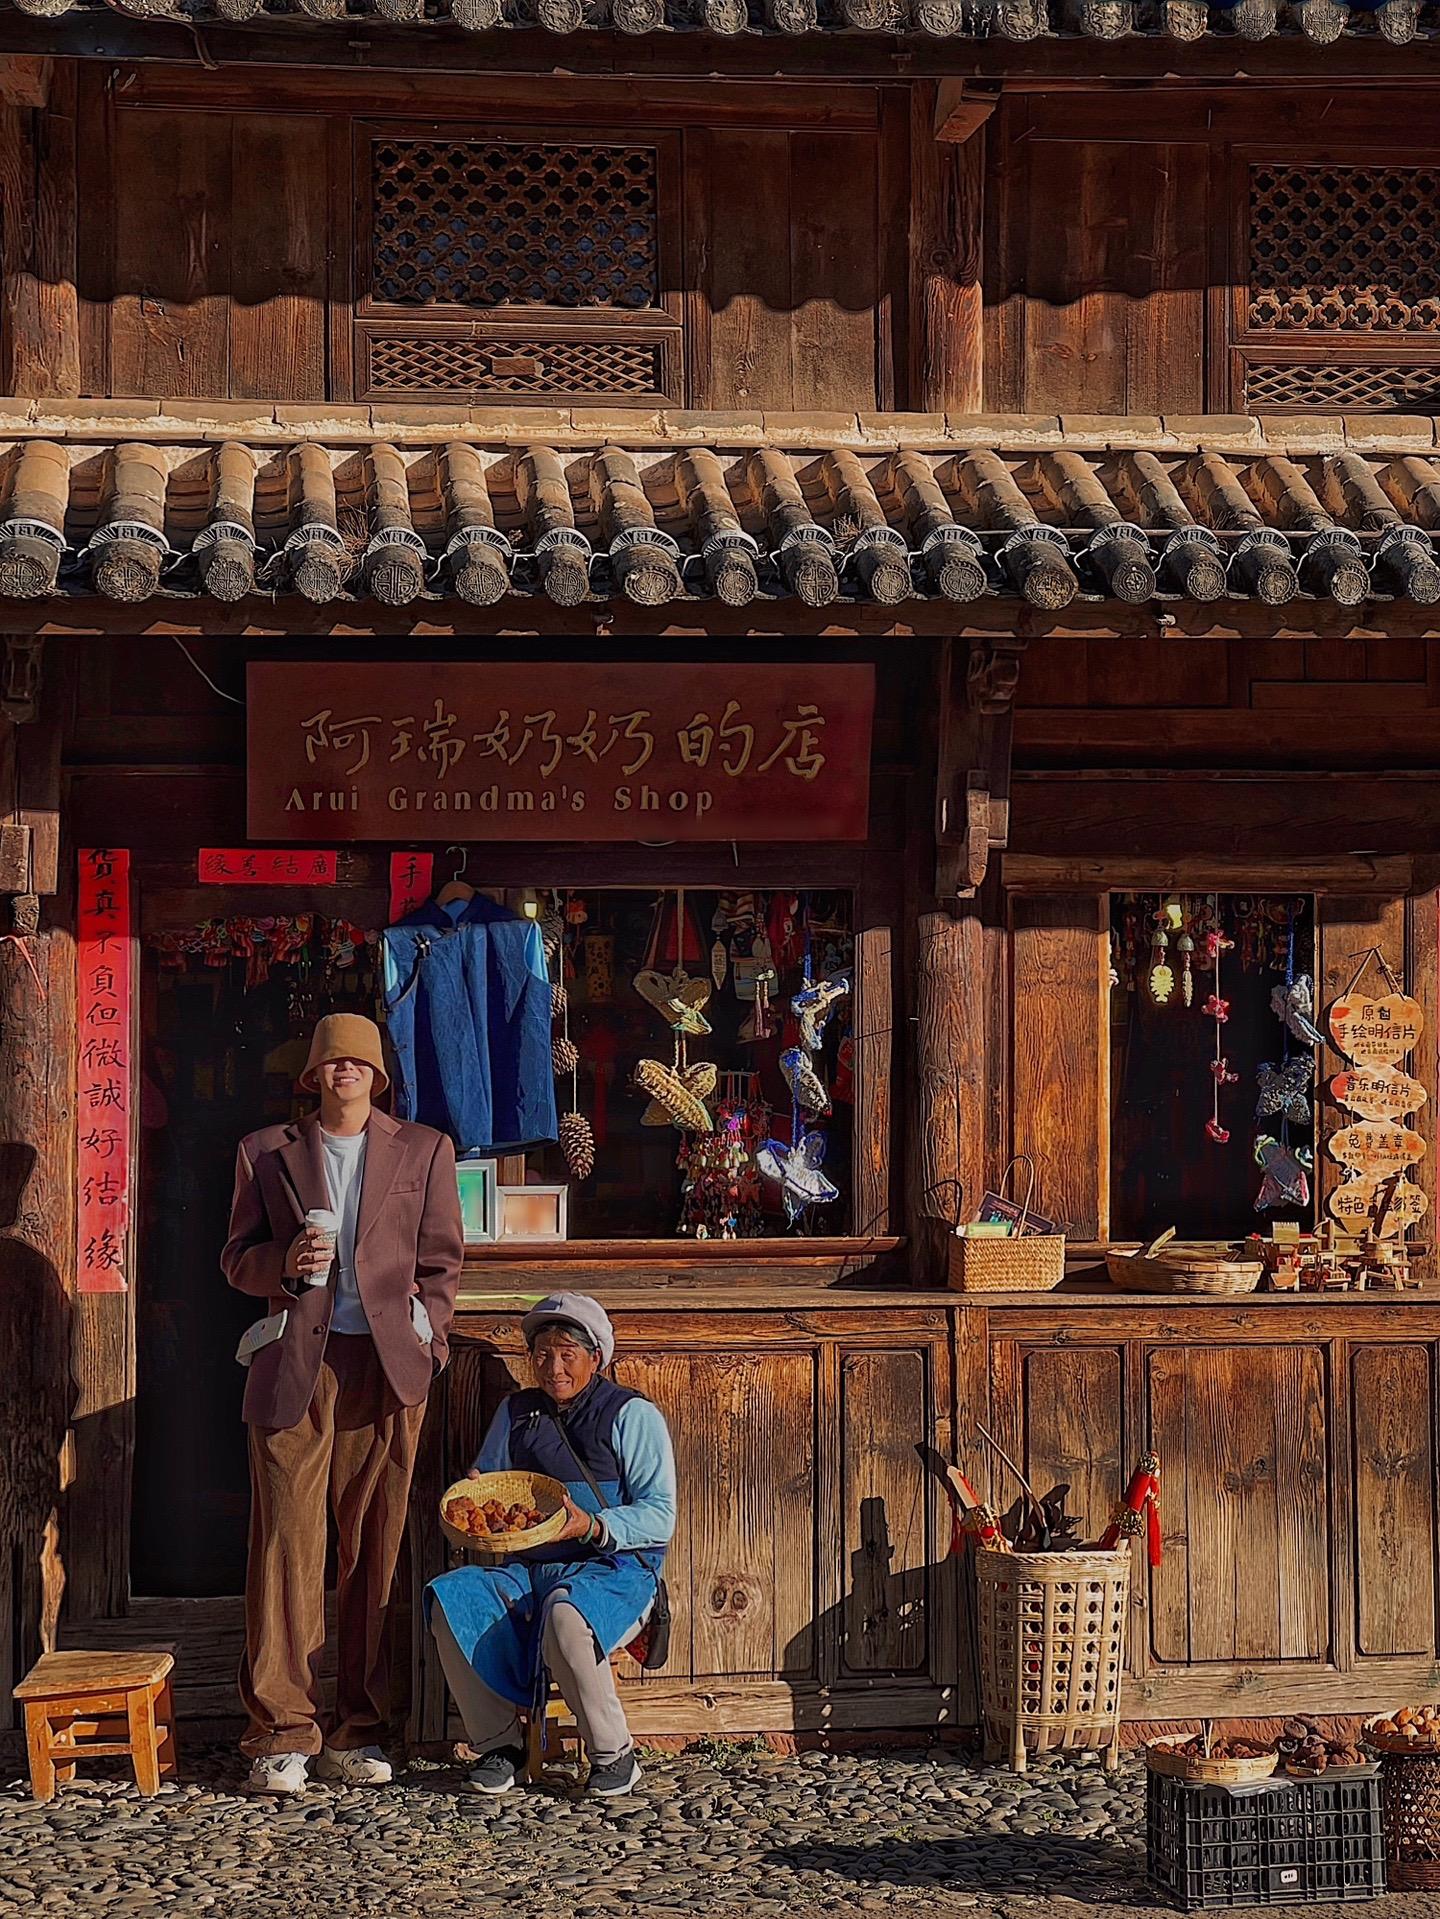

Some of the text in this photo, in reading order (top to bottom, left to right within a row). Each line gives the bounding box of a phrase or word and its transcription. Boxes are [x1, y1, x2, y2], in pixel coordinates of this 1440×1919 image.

[301, 698, 826, 780] 阿瑞奶奶的店
[285, 785, 714, 816] Arui Grandma's Shop
[1338, 1023, 1416, 1039] 手绘明信片
[1346, 1075, 1411, 1097] 音乐明信片
[1348, 1132, 1403, 1149] 免费盖章
